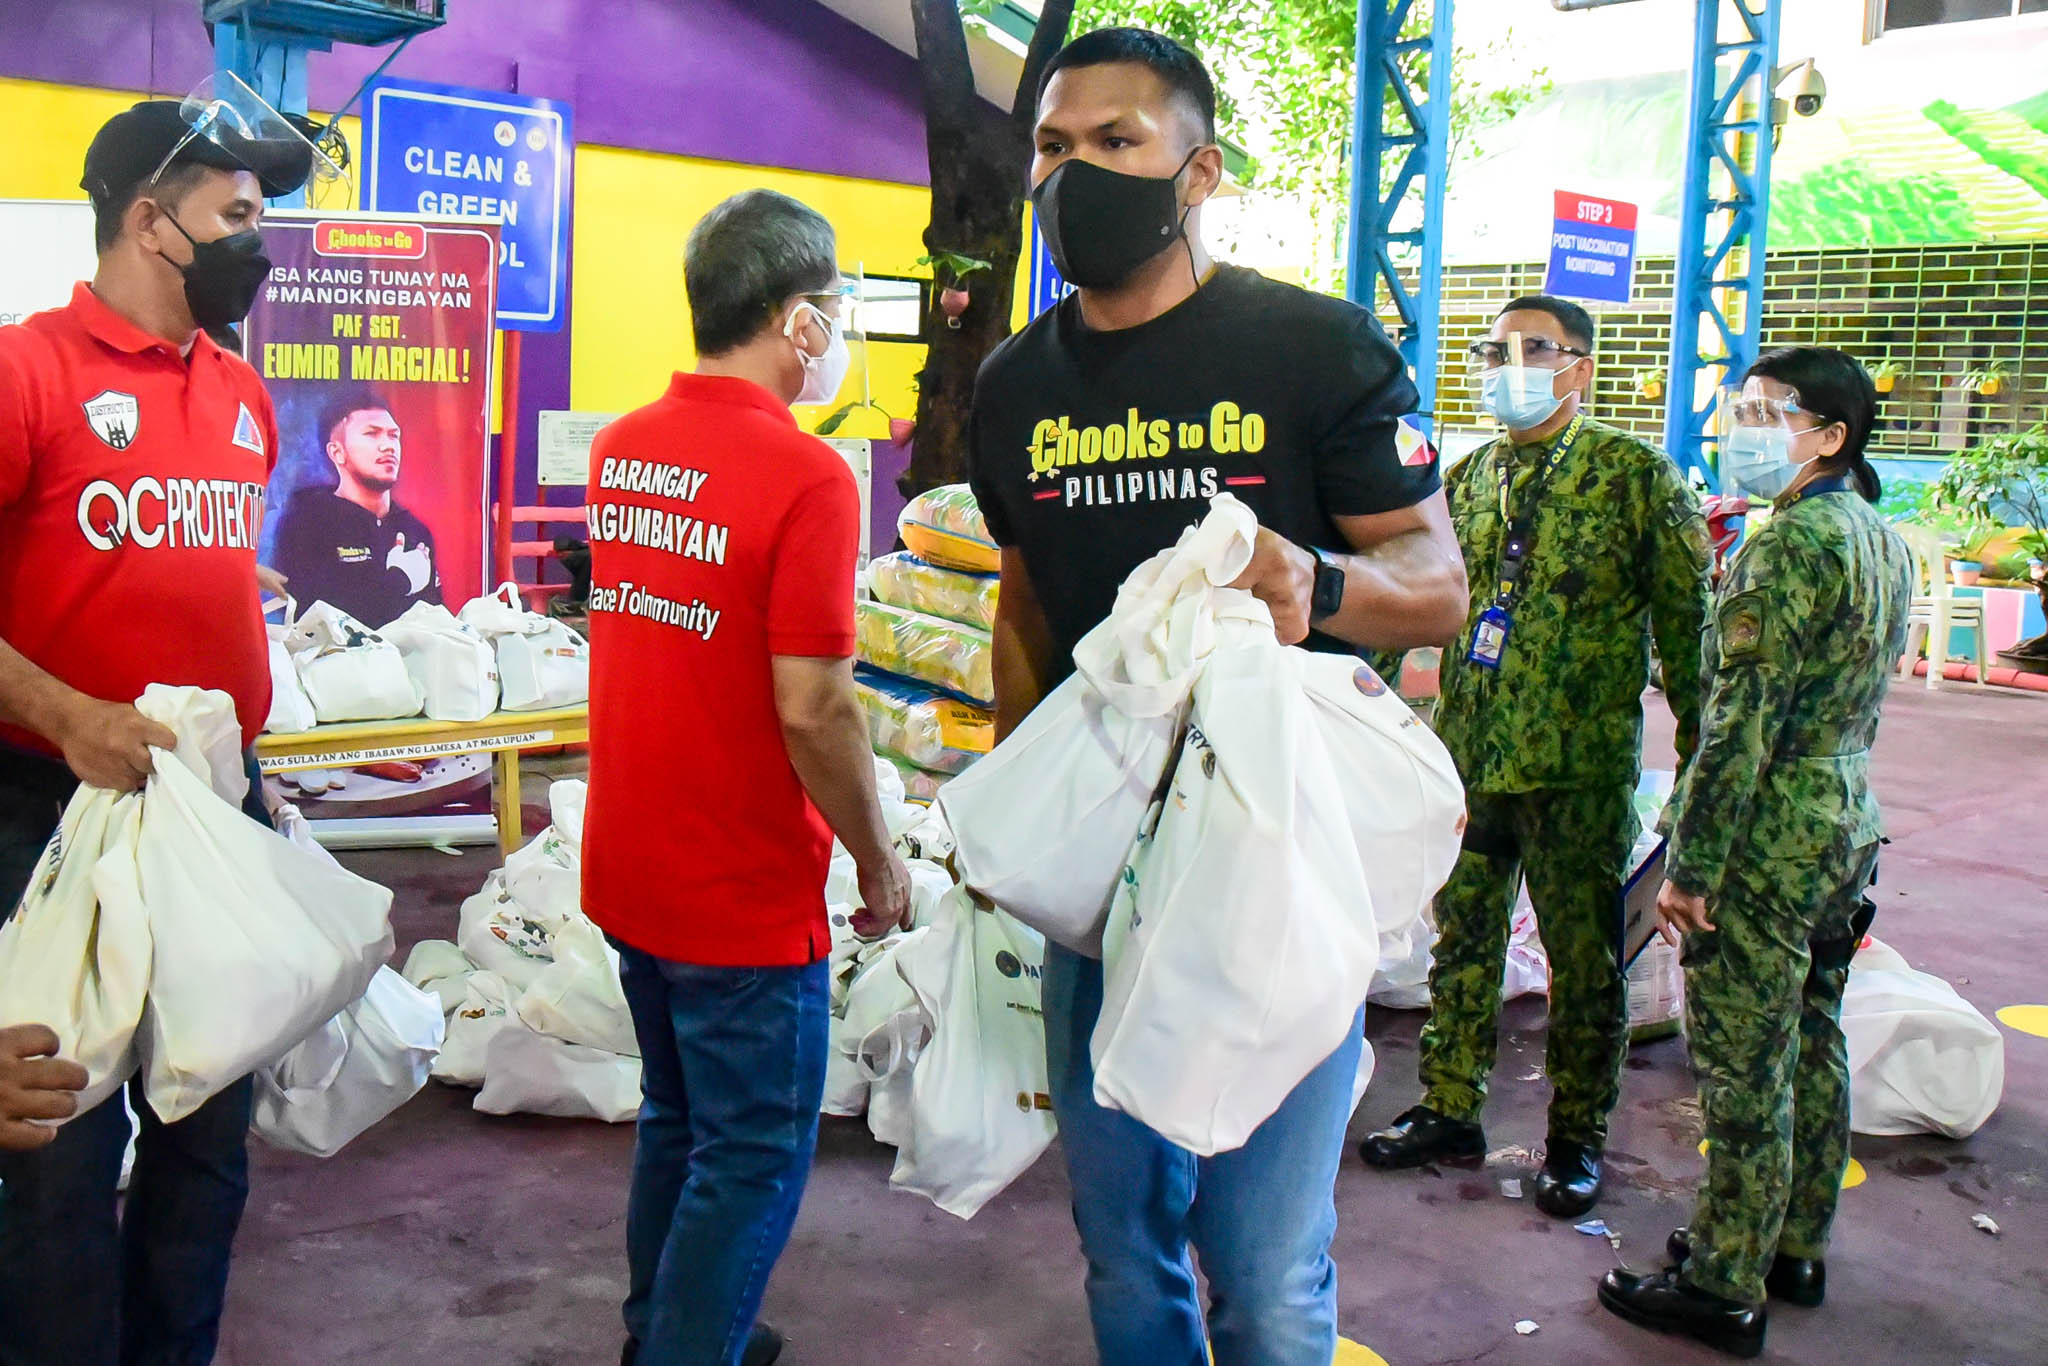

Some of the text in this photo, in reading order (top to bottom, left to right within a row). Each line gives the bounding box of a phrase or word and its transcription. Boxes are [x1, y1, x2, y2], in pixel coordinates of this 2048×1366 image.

[404, 146, 532, 187] CLEAN &
[417, 190, 518, 226] GREEN
[1577, 200, 1613, 224] STEP 3
[328, 228, 382, 249] Chooks
[394, 231, 413, 249] Go
[1553, 233, 1630, 258] POST VACCINATION
[269, 267, 470, 289] ISA KANG TUNAY NA
[1565, 256, 1616, 277] MONITORING
[265, 286, 472, 309] #MANOKNGBAYAN
[333, 314, 407, 340] PAF SGT.
[263, 343, 470, 384] EUMIR MARCIAL!
[1029, 401, 1265, 475] Chooks to Go
[600, 456, 709, 503] BARANGAY
[1066, 467, 1219, 507] PILIPINAS
[585, 503, 728, 566] AGUMBAYAN
[260, 733, 536, 768] WAG SULATAN ANG IBABAW NG LAMESA AT MGA UPUAN
